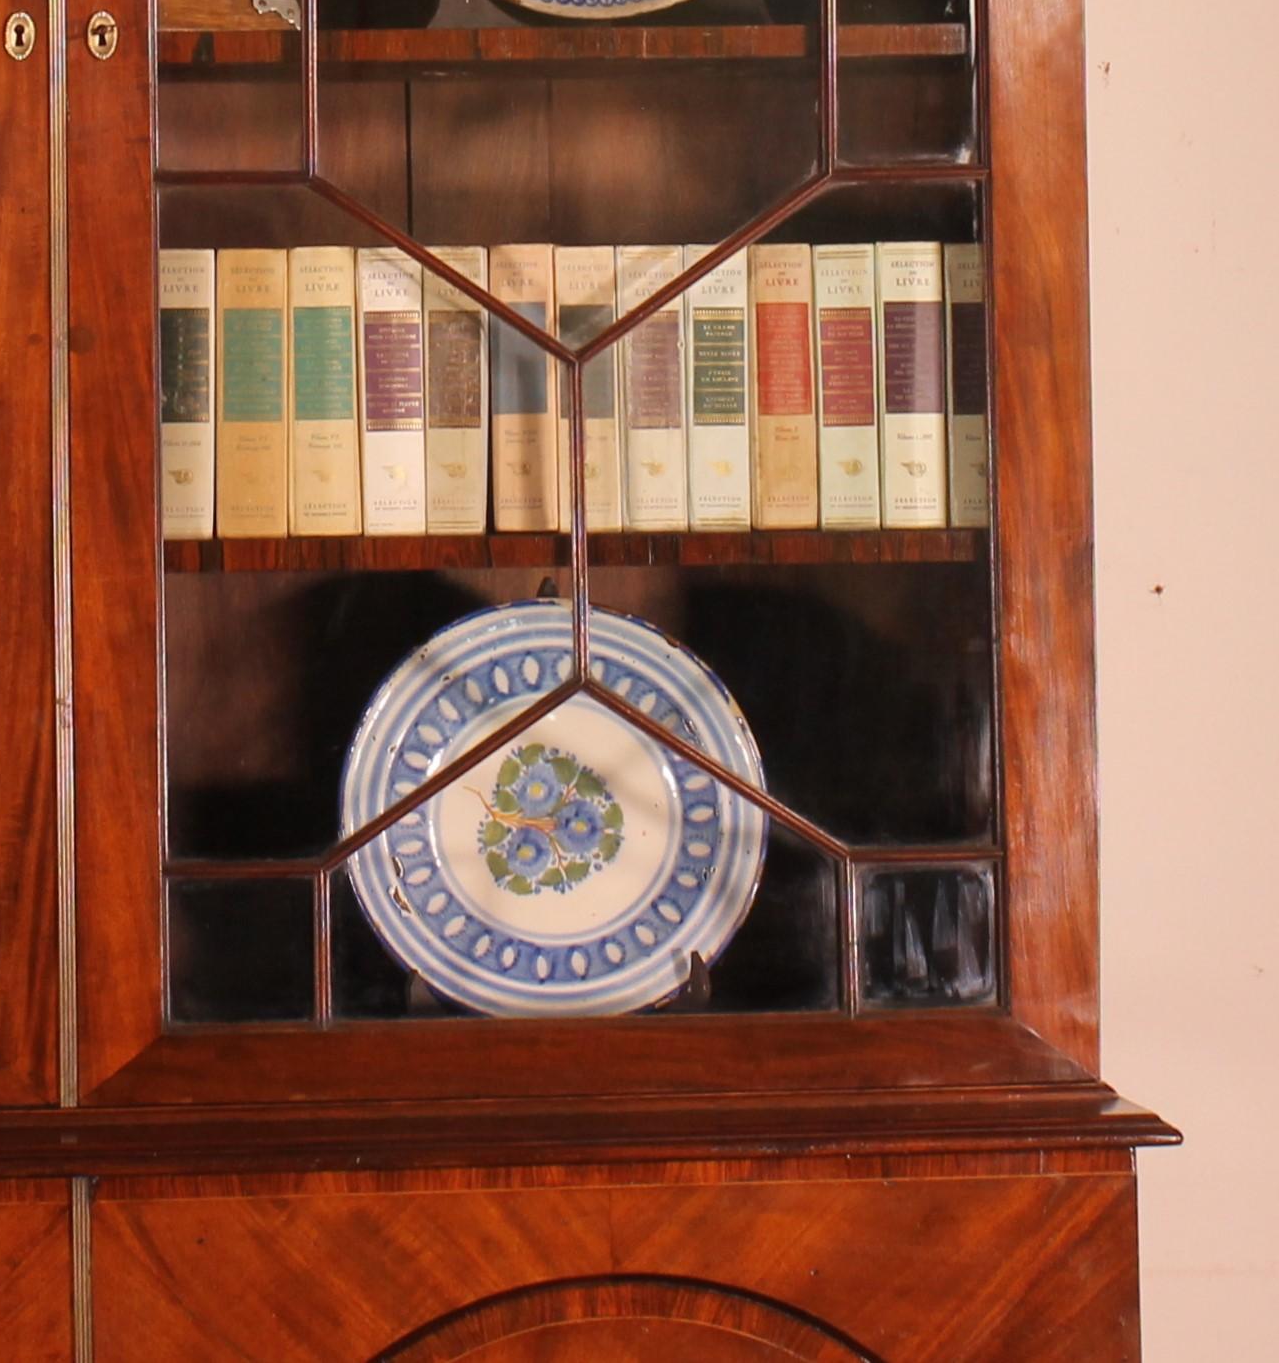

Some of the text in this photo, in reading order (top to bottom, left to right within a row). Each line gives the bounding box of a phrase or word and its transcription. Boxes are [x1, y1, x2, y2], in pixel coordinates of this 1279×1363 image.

[765, 278, 799, 286] LIVRE
[895, 277, 930, 287] LIVRE
[163, 284, 200, 294] LIVRE
[305, 283, 340, 292] LIVRE
[701, 286, 737, 294] LIVRE
[827, 285, 863, 294] LIVRE
[374, 288, 409, 297] LIVRE
